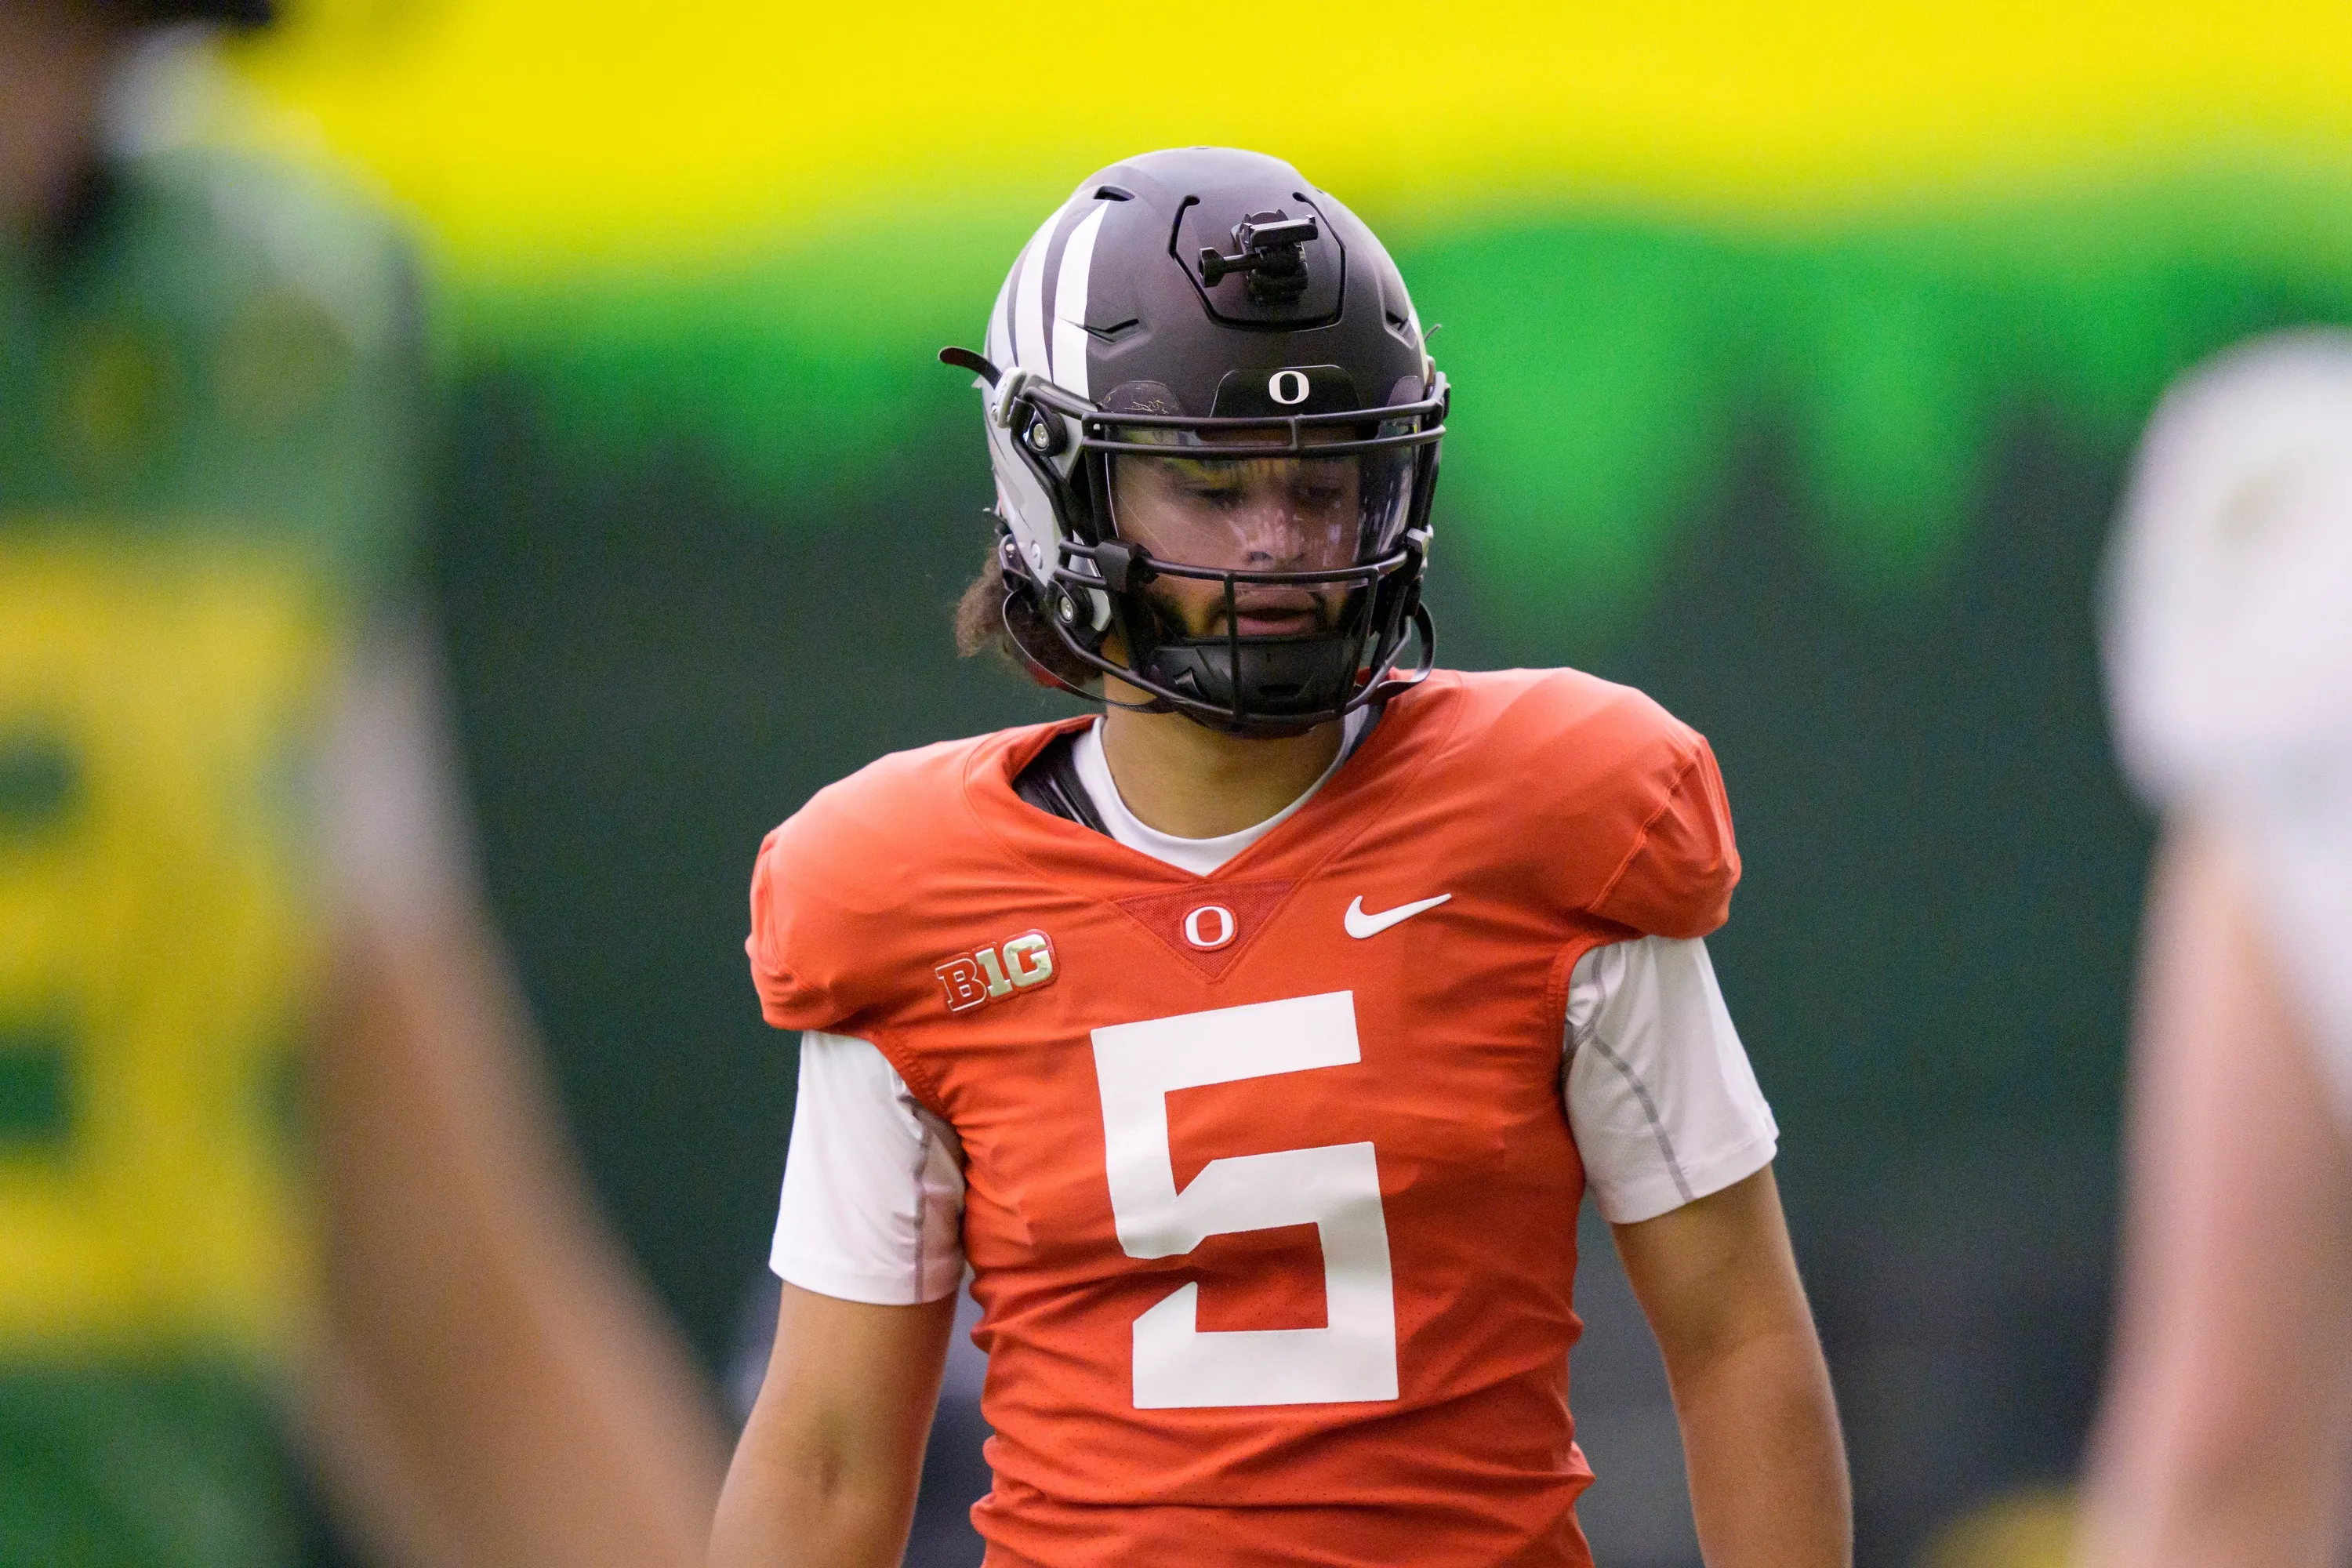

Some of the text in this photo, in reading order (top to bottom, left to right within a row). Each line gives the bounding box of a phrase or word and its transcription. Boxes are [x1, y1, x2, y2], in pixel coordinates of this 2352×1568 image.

[1269, 371, 1310, 405] O
[1185, 906, 1234, 946] O
[1091, 989, 1399, 1409] 5
